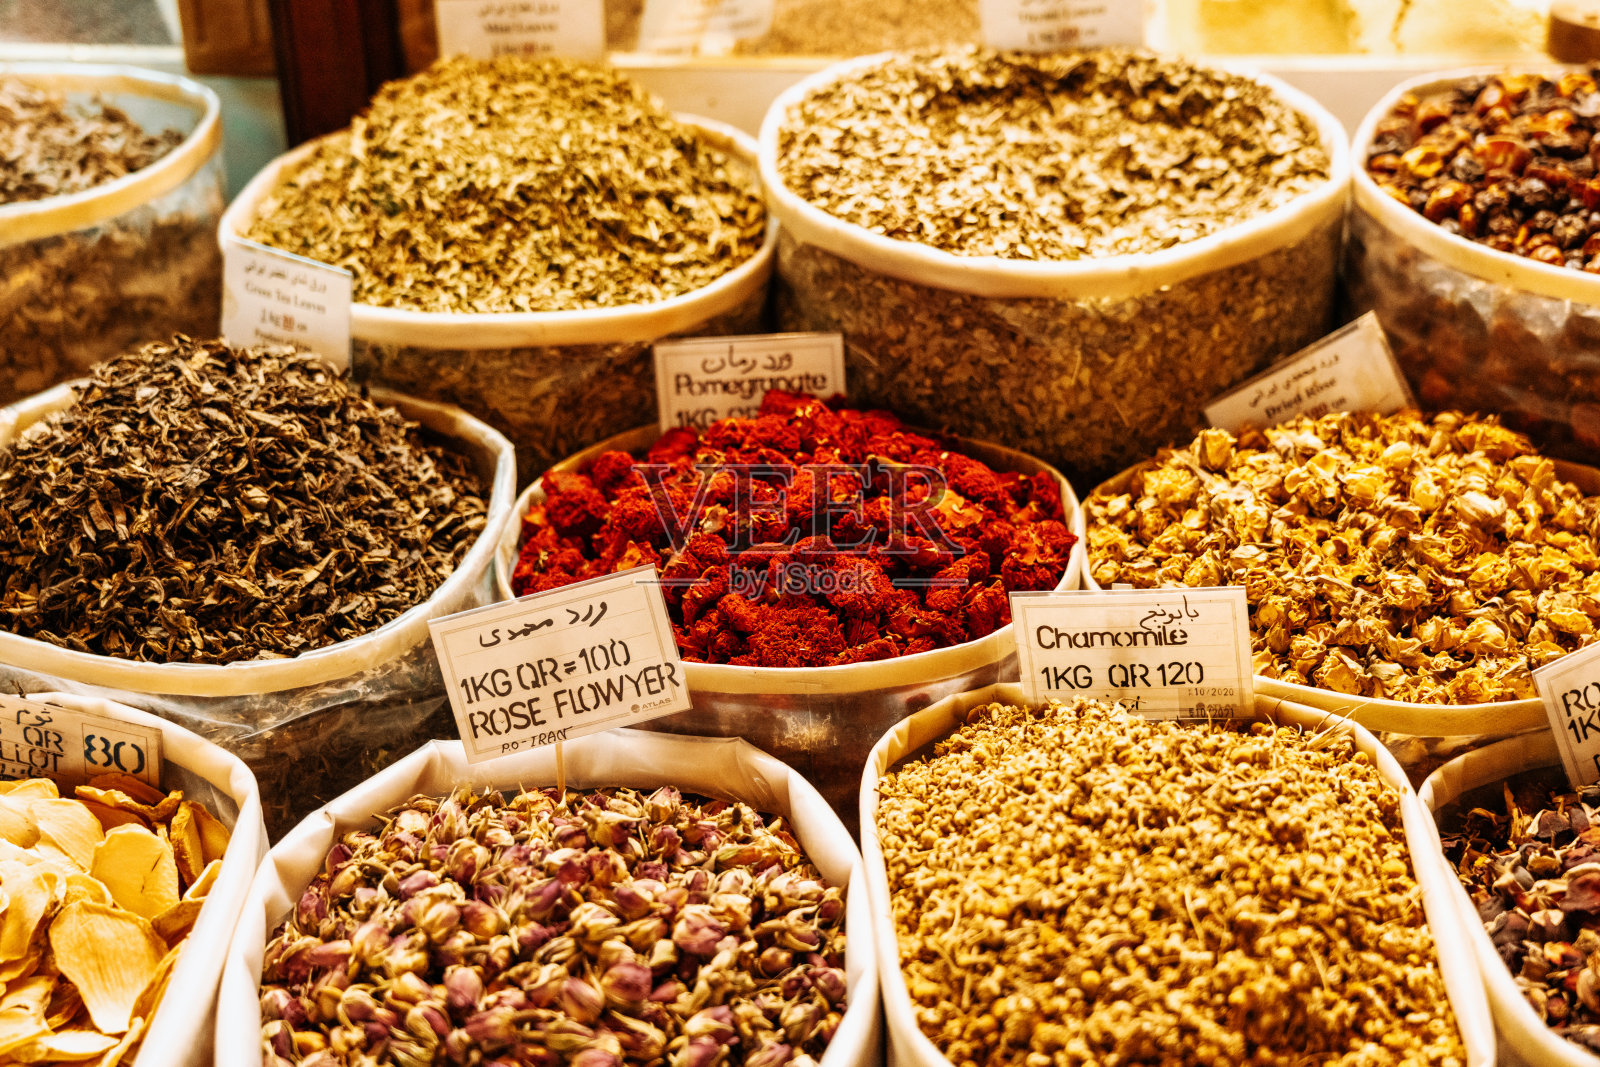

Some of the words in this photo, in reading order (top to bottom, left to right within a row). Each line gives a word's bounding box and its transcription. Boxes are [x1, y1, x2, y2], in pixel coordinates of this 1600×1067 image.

[566, 601, 608, 627] ورد
[1036, 624, 1189, 650] Chamomile
[460, 667, 513, 705] 1KG
[1041, 664, 1093, 690] 1KG
[1108, 663, 1152, 688] QR
[1156, 661, 1205, 687] 120
[468, 697, 547, 739] ROSE
[552, 662, 680, 719] FLOWYER
[641, 697, 671, 710] ATLAS
[23, 726, 64, 753] QR
[84, 734, 145, 774] 80
